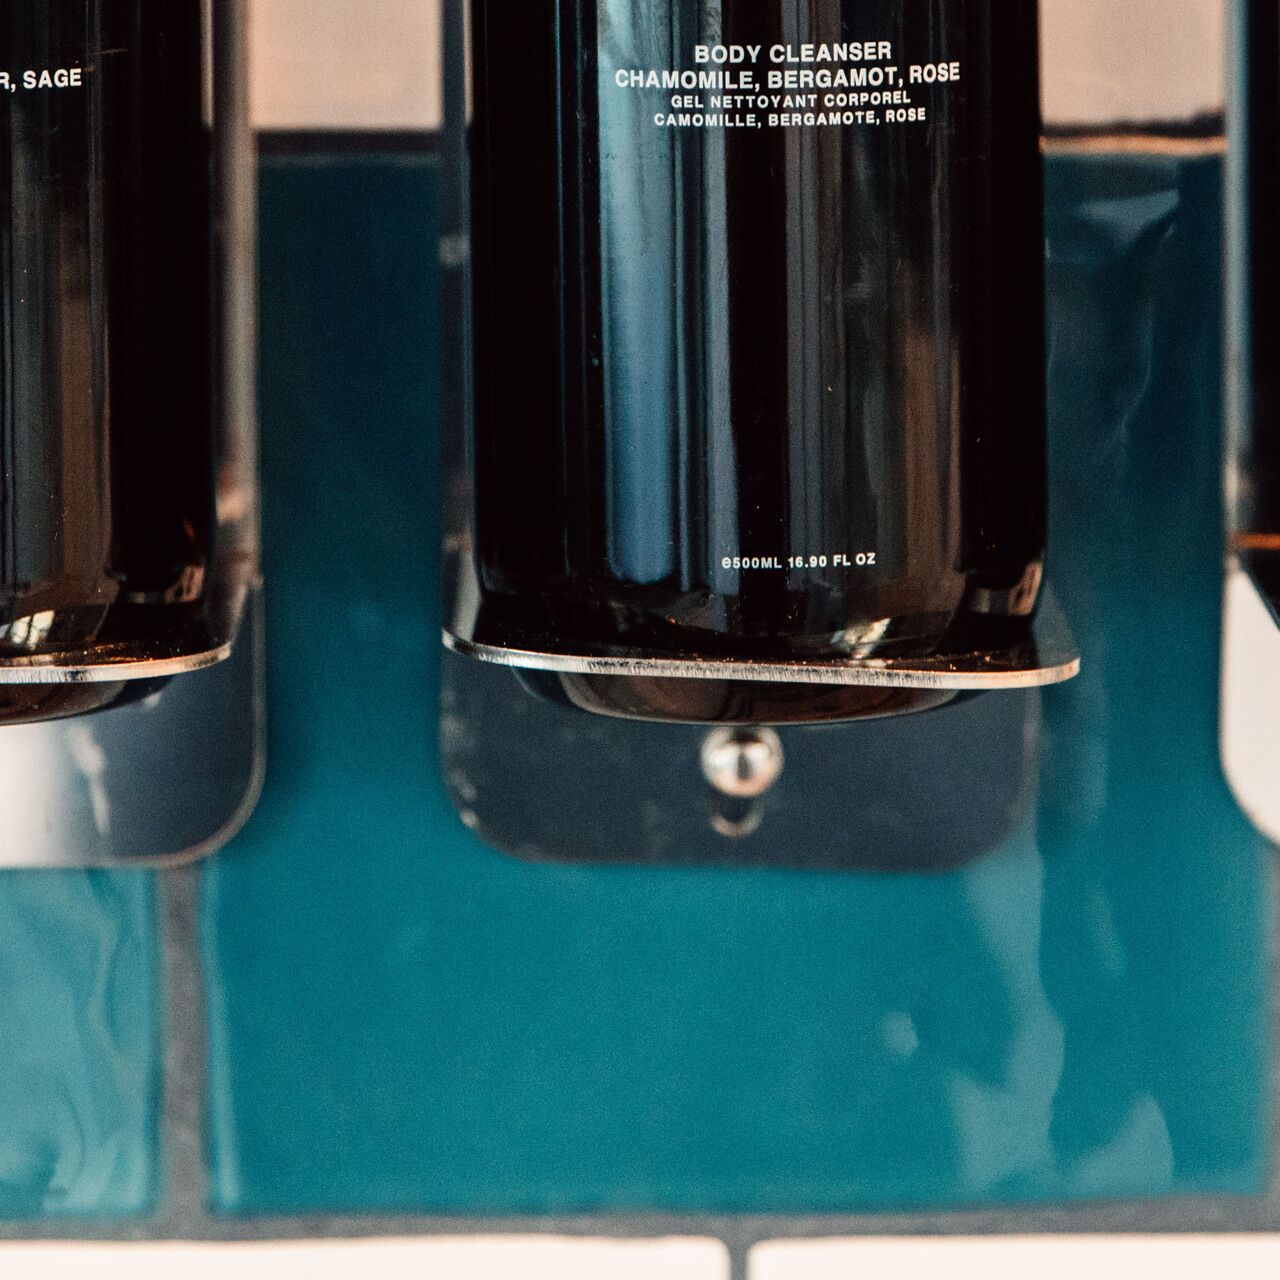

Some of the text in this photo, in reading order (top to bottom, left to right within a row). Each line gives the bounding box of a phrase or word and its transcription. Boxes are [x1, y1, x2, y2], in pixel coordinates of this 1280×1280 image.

[695, 41, 892, 64] BODY CLEANSER
[23, 68, 82, 89] SAGE
[615, 62, 961, 92] CHAMOMILE, BERGAMOT, ROSE
[671, 91, 911, 108] GEL NETTOYANT CORPOREL
[654, 108, 926, 128] CAMOMILLE, BERGAMOTE, ROSE
[788, 556, 827, 568] 16.90
[833, 554, 851, 566] FL
[856, 553, 876, 565] OZ
